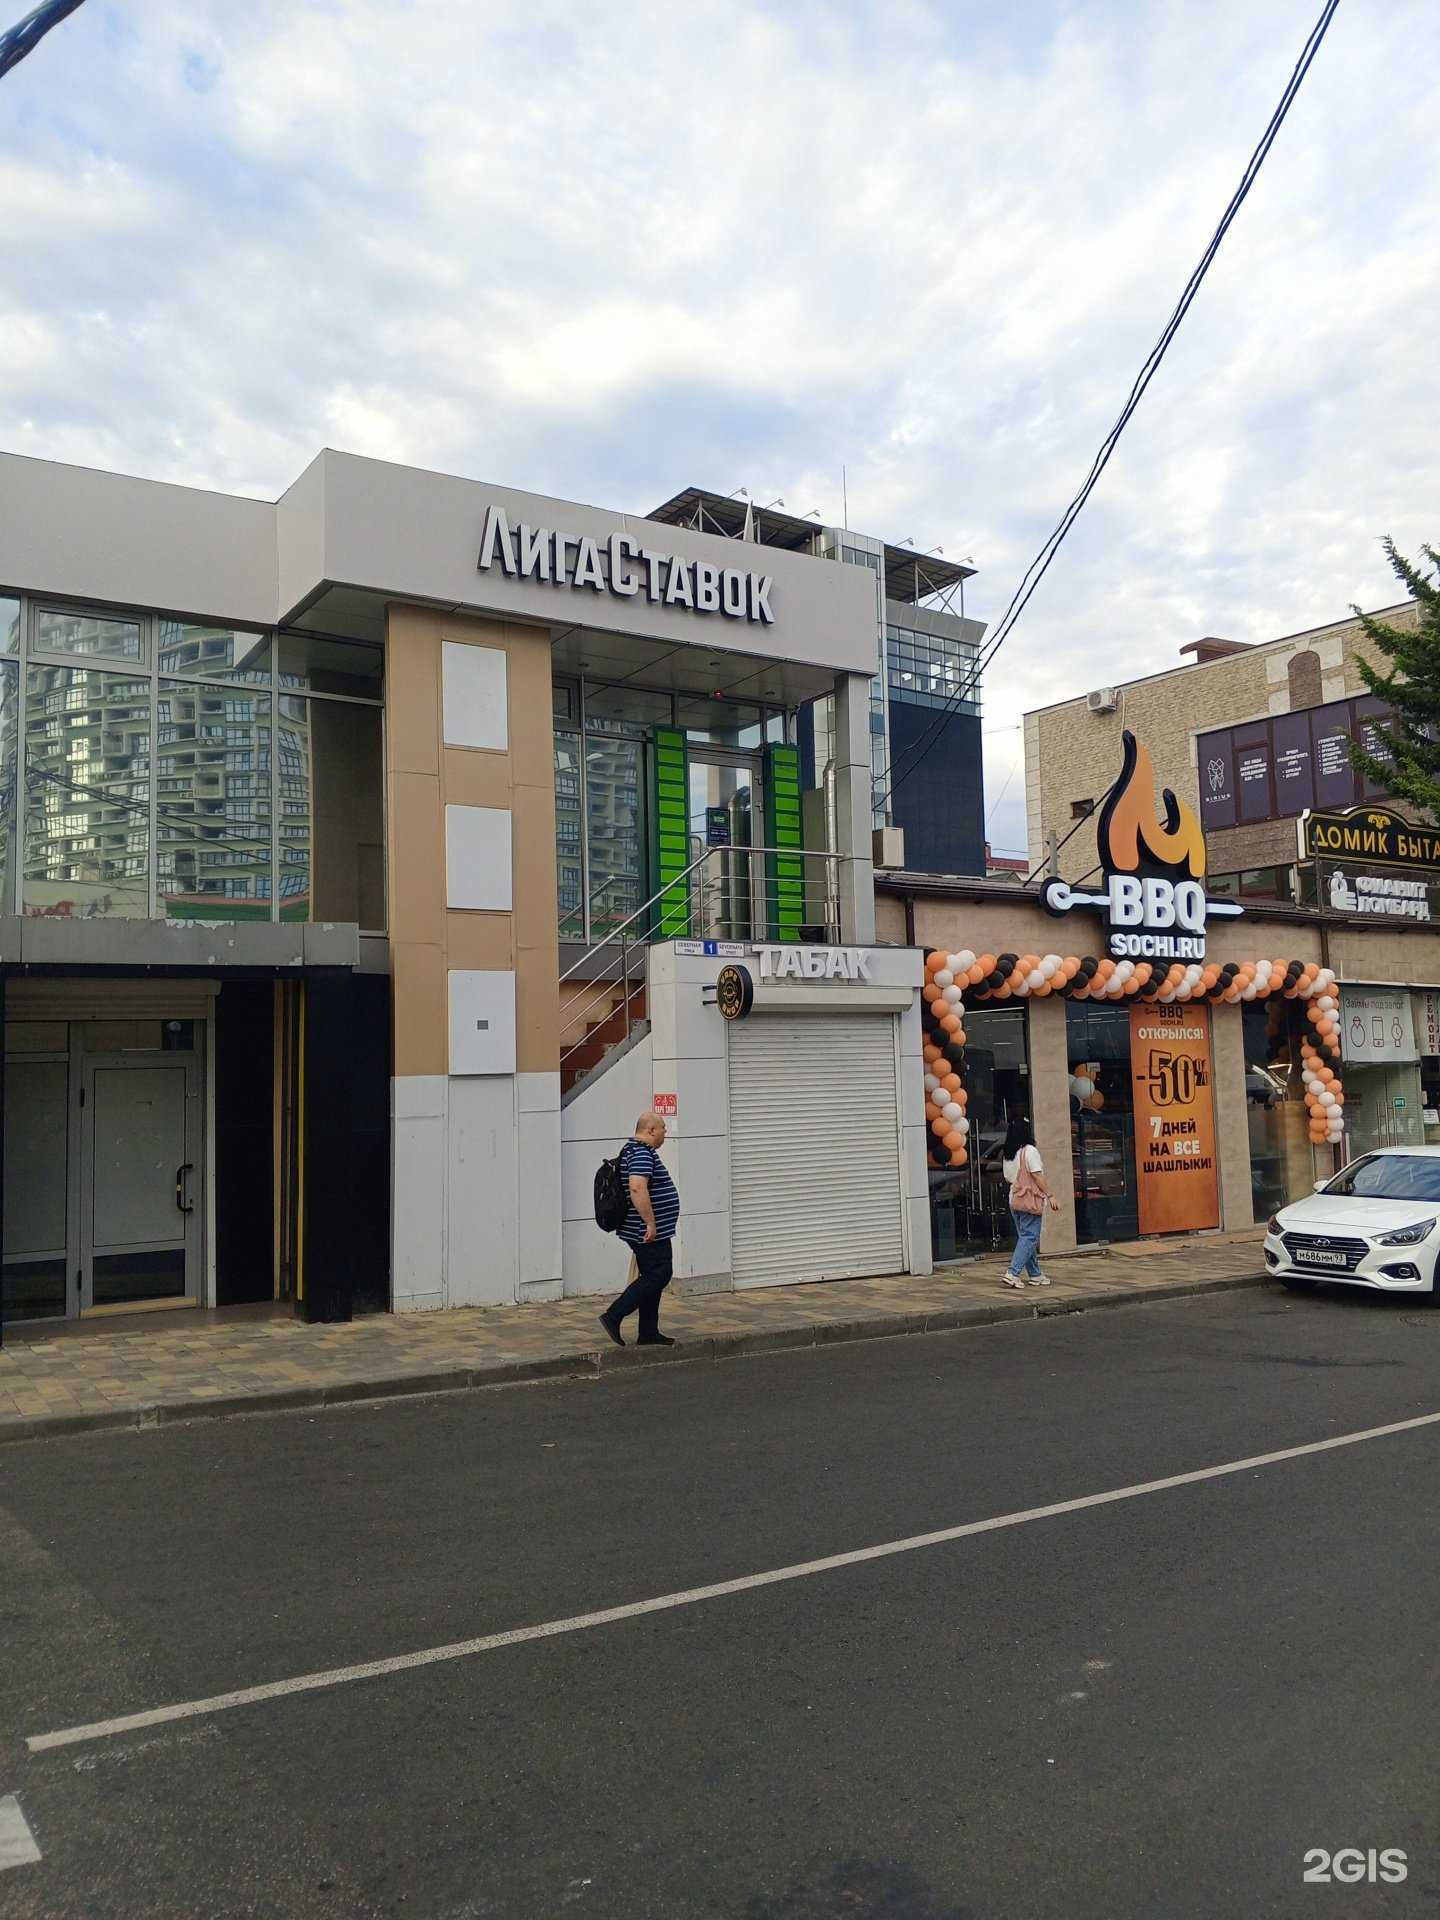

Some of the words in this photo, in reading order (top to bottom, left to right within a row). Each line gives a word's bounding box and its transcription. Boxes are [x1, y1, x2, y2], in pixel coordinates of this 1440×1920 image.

[1312, 824, 1389, 854] ДОМИК
[1109, 875, 1206, 934] BBQ
[1357, 895, 1431, 921] ЛОМБАРД
[708, 943, 713, 954] 1
[1110, 933, 1206, 959] SOCHI.RU
[752, 944, 872, 980] ТАБАК
[1159, 1005, 1183, 1018] BBQ
[1138, 1027, 1204, 1040] ОТКРЫЛСЯ!
[1426, 994, 1435, 1054] РЕМОНТ
[1150, 1116, 1162, 1138] 7
[1162, 1118, 1196, 1136] ДНЕЙ
[1150, 1142, 1171, 1157] НА
[1173, 1139, 1201, 1156] ВСЕ
[1143, 1157, 1212, 1174] ШАШЛЫКИ!
